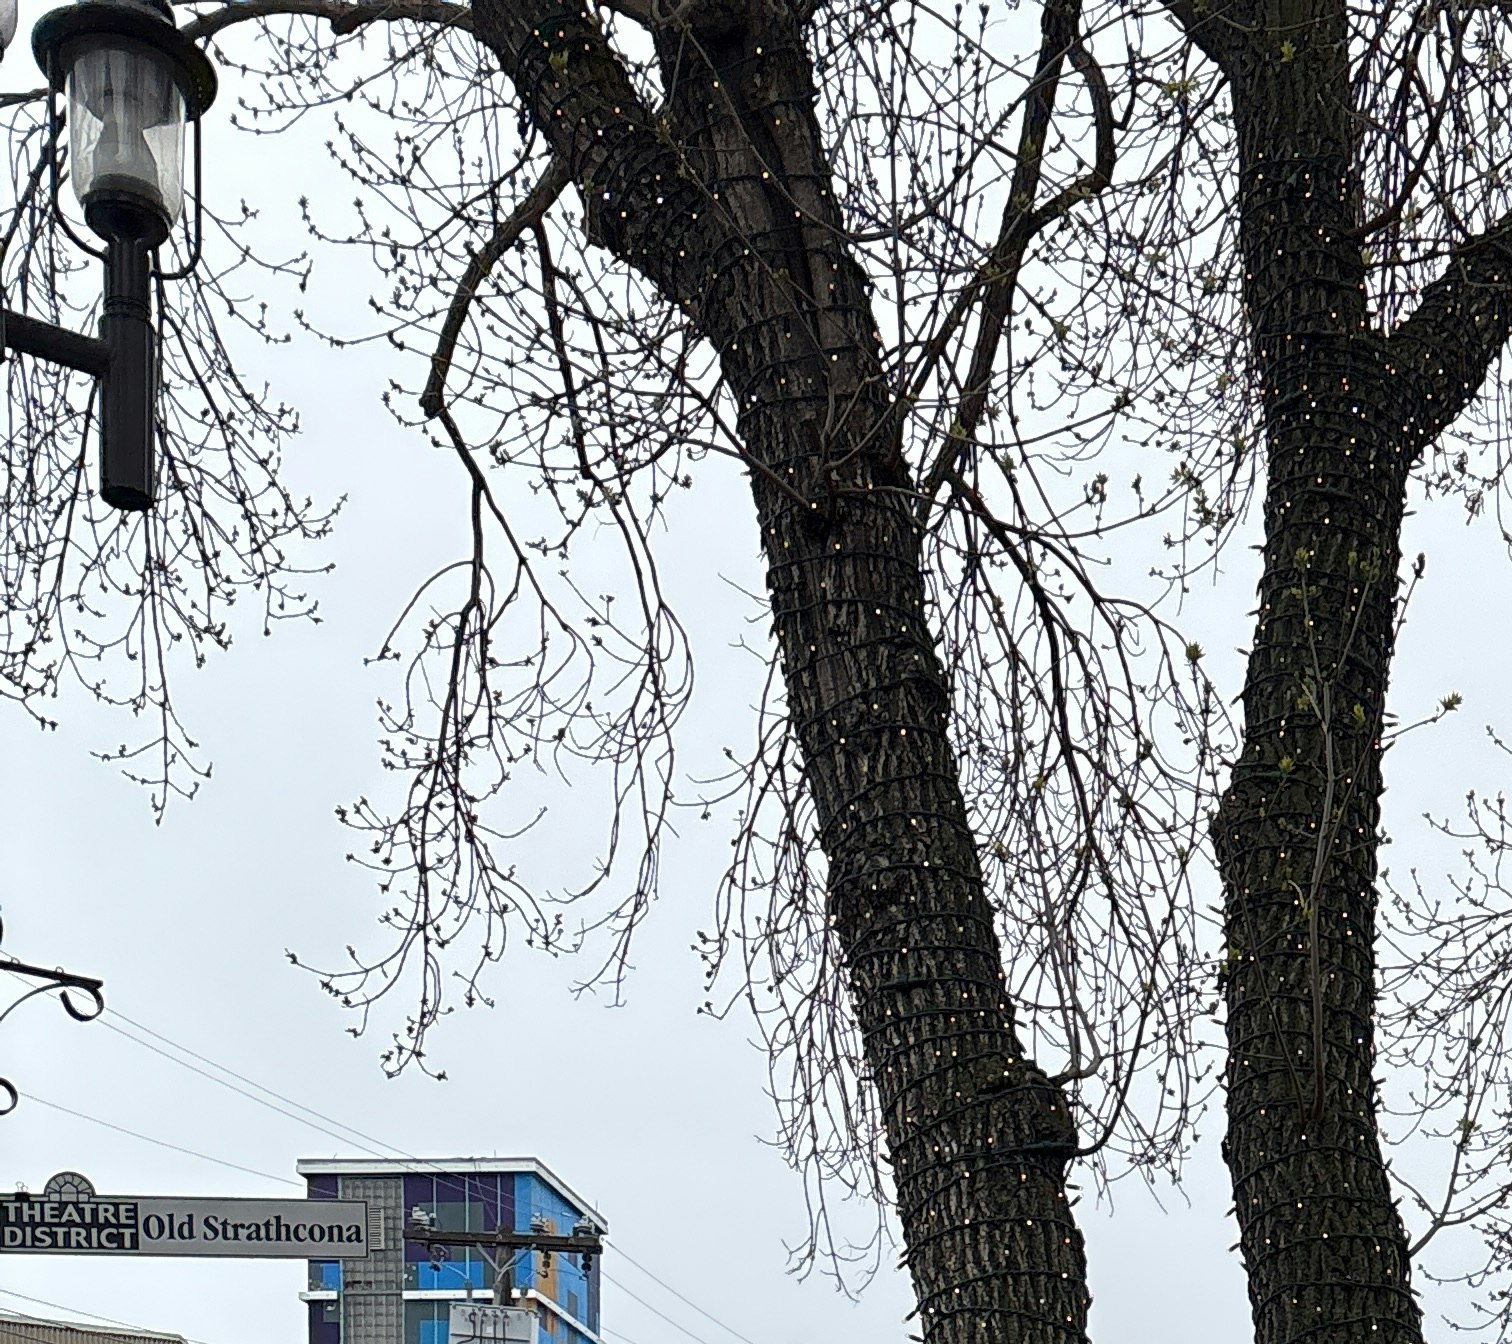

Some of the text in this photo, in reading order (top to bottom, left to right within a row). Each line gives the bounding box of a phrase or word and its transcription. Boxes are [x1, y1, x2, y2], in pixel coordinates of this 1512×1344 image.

[3, 1201, 136, 1224] THEATRE
[4, 1227, 137, 1249] DISTRICT
[143, 1213, 363, 1244] Old Strathcona
